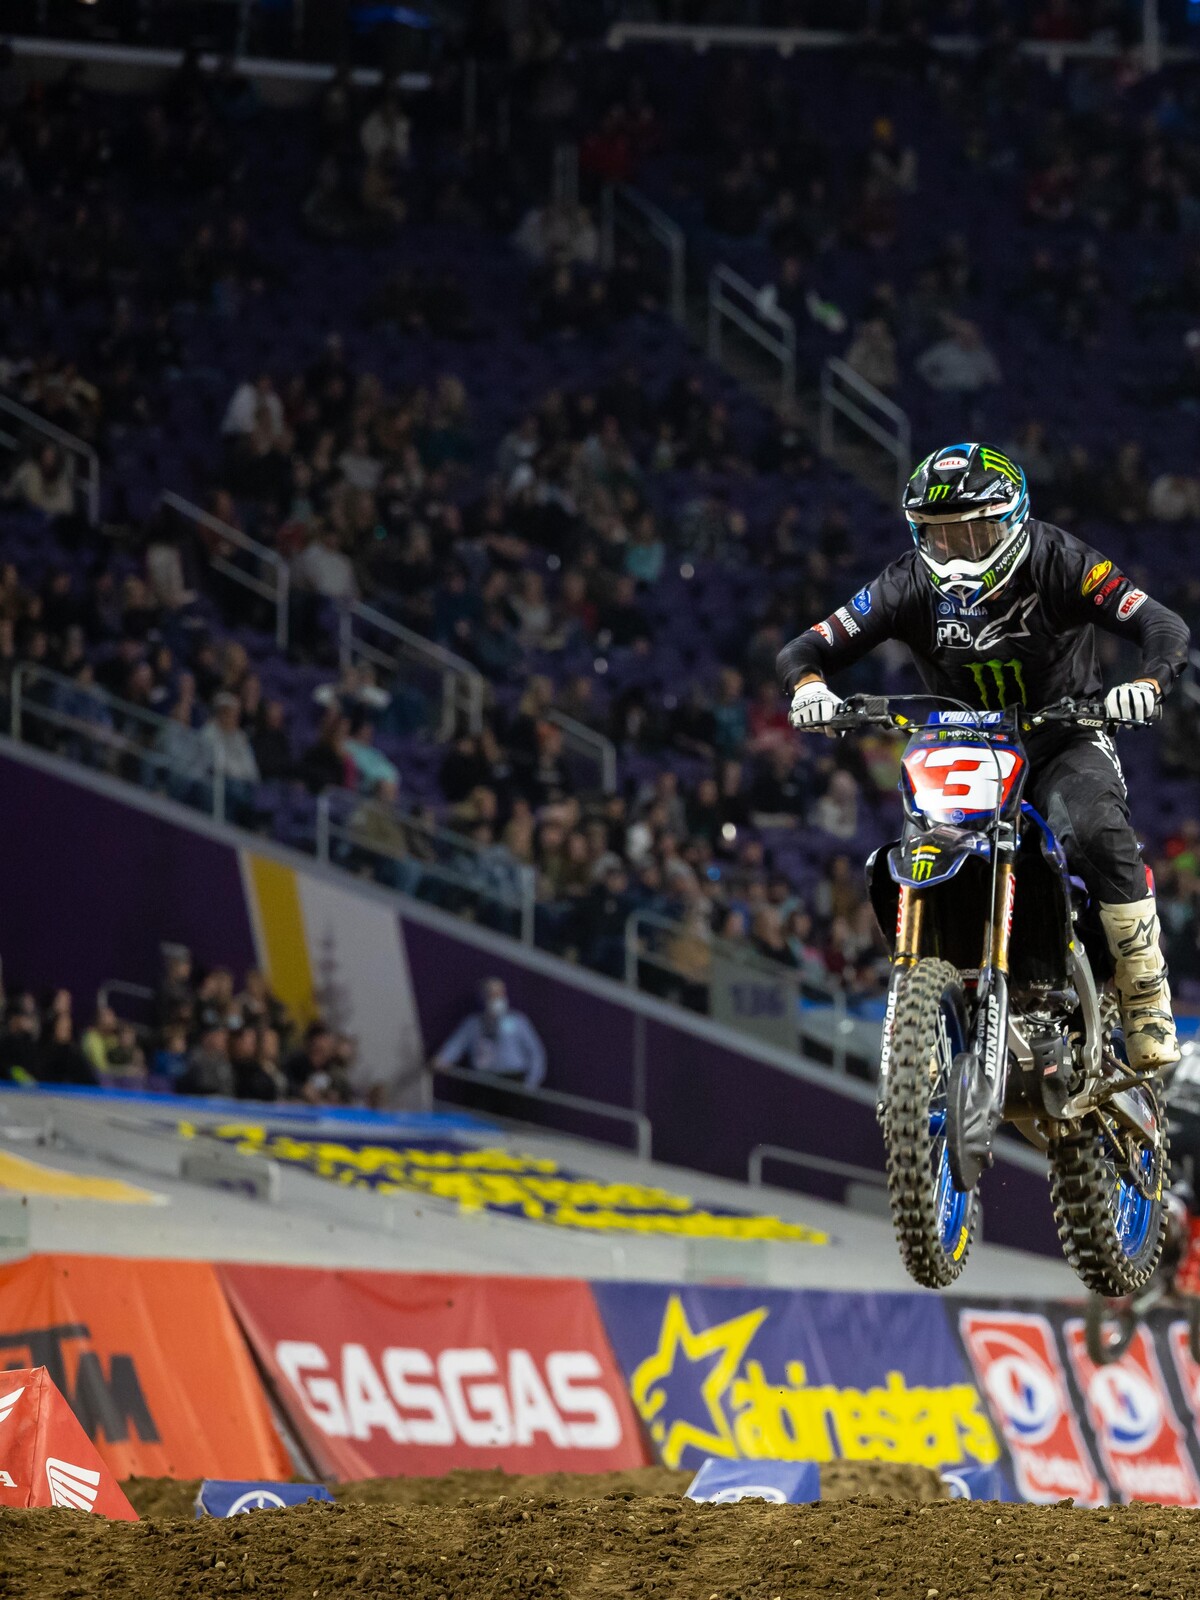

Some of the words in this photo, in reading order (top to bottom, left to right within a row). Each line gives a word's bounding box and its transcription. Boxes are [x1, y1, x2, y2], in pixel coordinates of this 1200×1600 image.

[995, 530, 1027, 572] MONSTER
[914, 747, 1016, 810] 3
[985, 994, 1000, 1080] DUNLOP
[0, 1323, 163, 1444] TM
[275, 1340, 622, 1450] GASGAS
